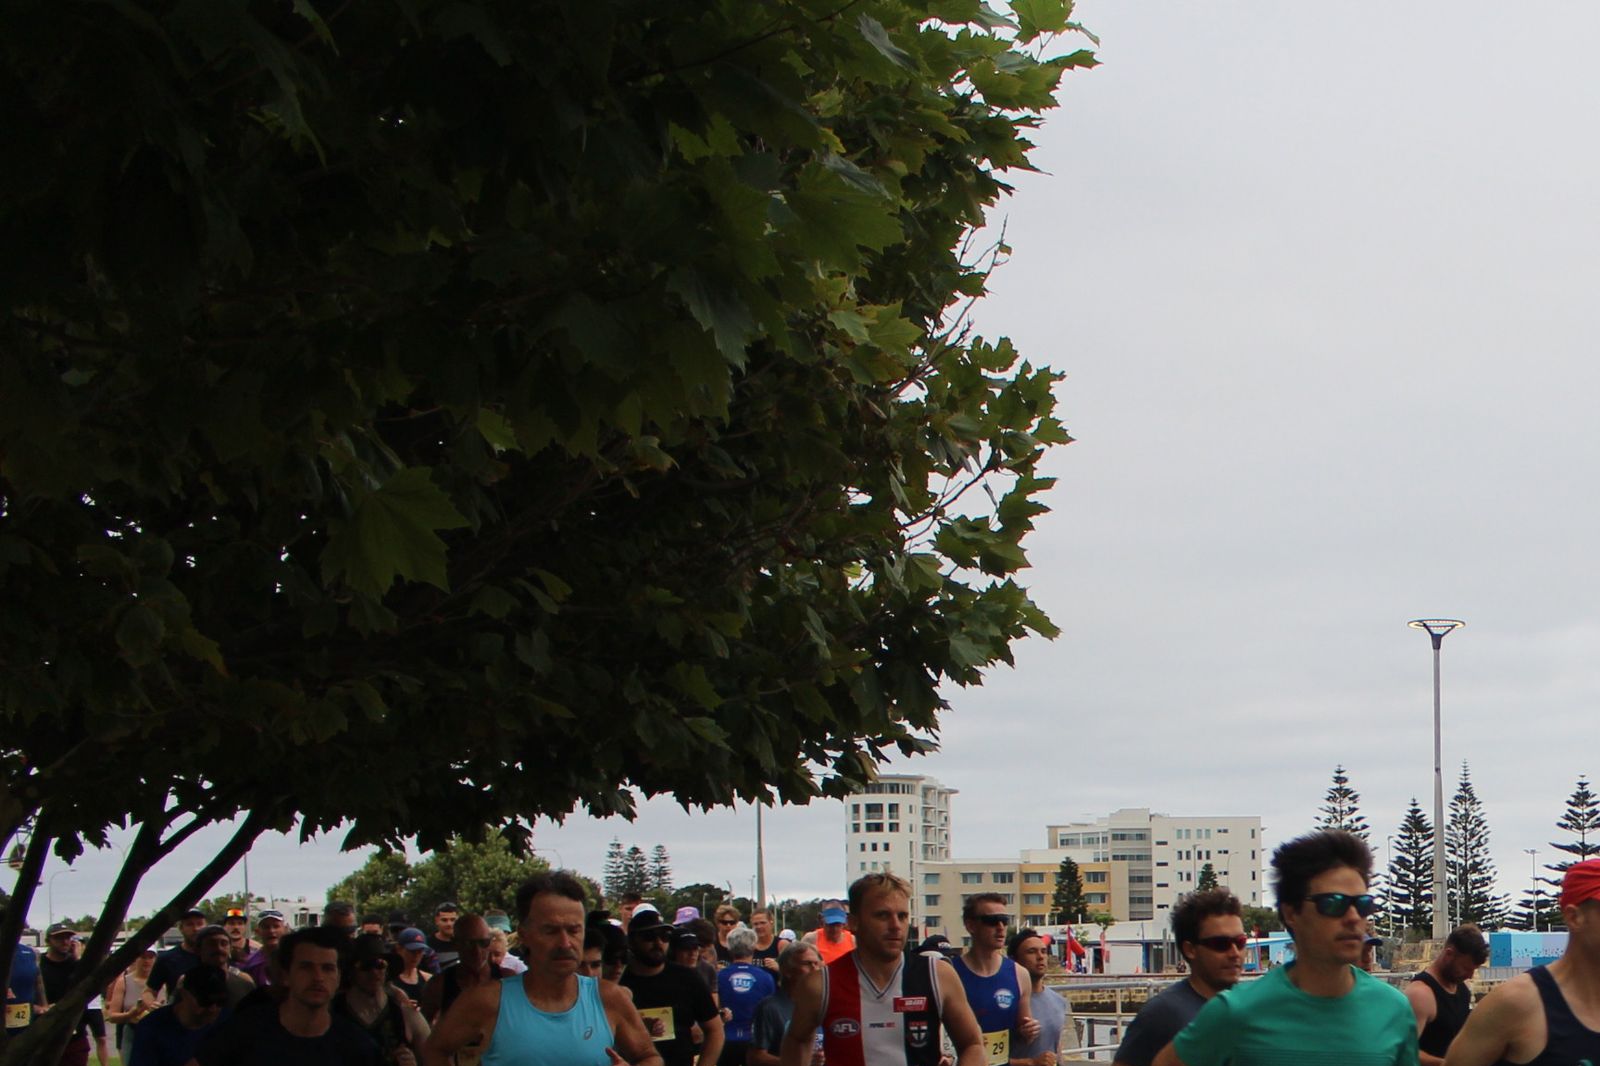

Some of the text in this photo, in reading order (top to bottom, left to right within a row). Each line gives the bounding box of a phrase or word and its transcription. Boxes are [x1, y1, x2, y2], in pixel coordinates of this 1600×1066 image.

[15, 1010, 26, 1019] 42
[832, 1023, 857, 1033] AFL
[992, 1042, 1005, 1055] 29
